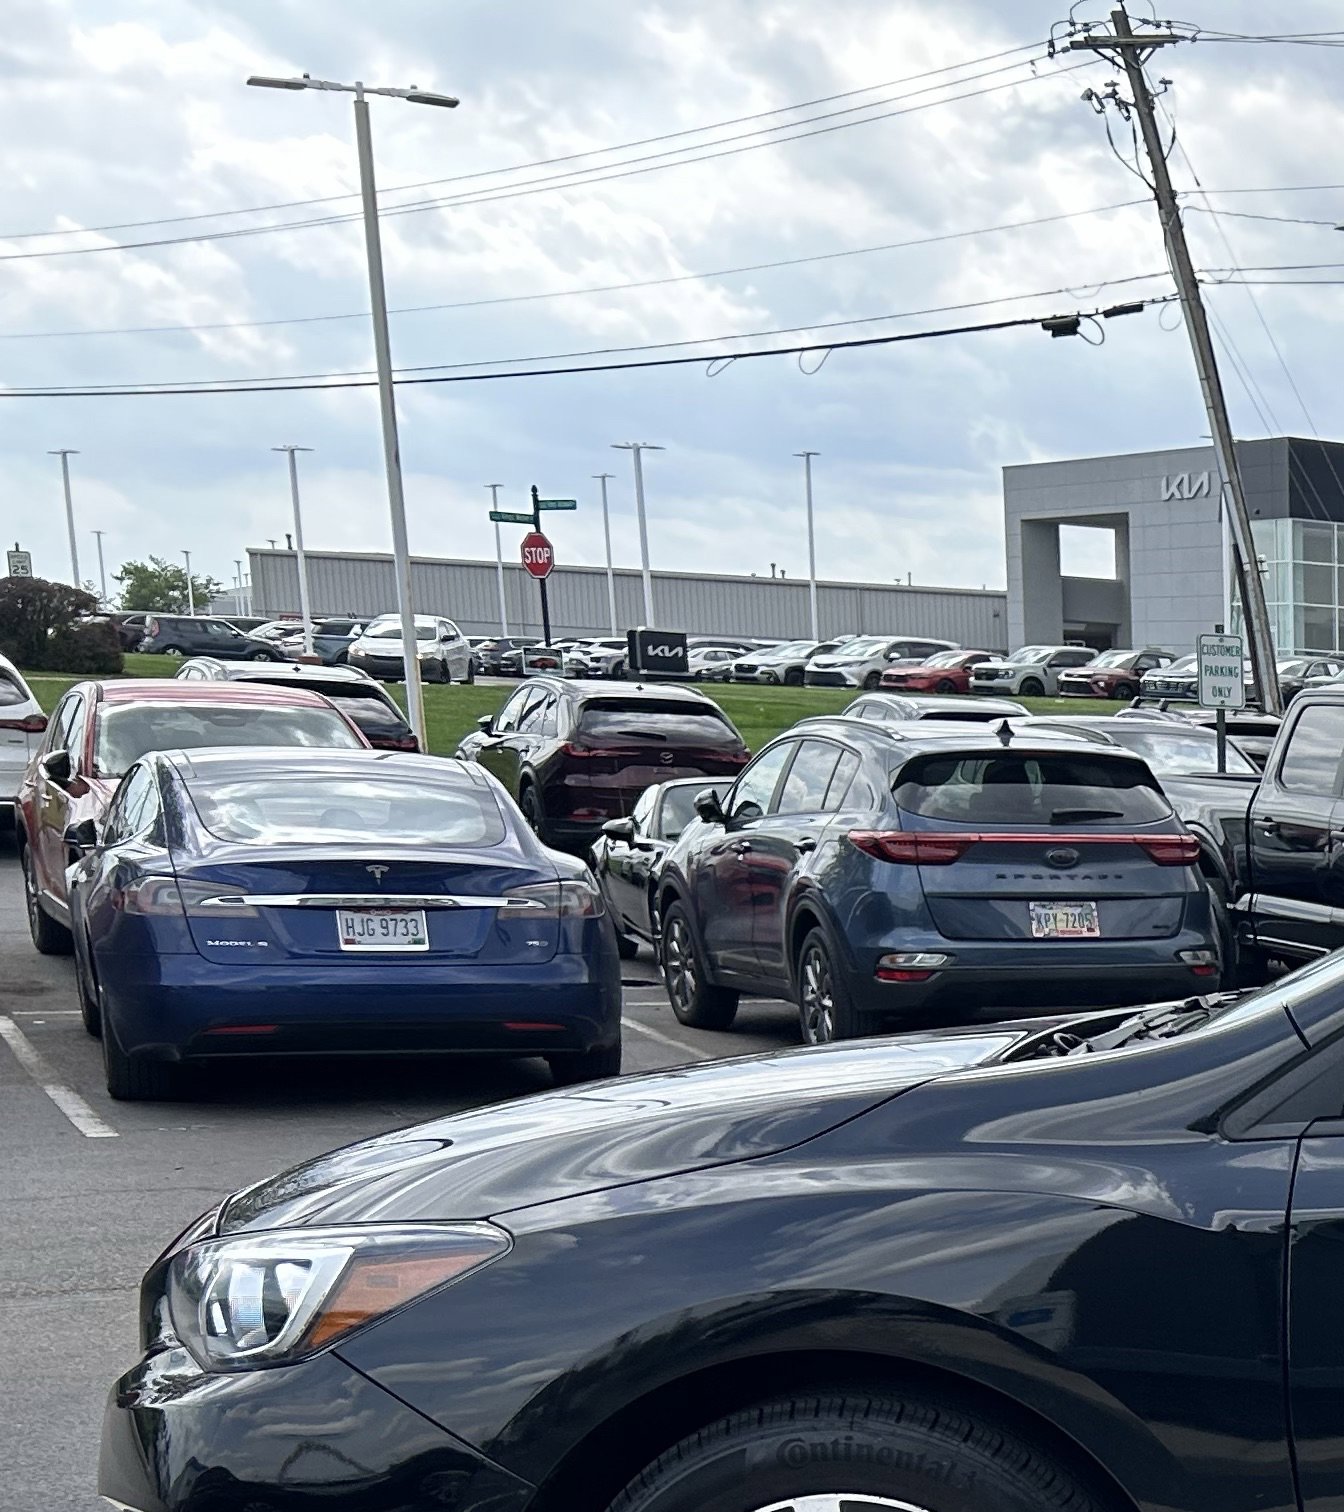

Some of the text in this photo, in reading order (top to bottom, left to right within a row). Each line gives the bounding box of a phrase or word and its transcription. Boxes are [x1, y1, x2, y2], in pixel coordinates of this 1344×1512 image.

[1161, 471, 1211, 501] KIA
[524, 547, 551, 564] STOP
[12, 564, 29, 575] 25
[647, 645, 684, 658] KIA
[1201, 644, 1241, 657] CUSTOMER
[1204, 665, 1239, 678] PARKING
[1212, 686, 1232, 698] ONLY
[345, 918, 420, 937] HJG 9733
[775, 1436, 957, 1484] Continental
